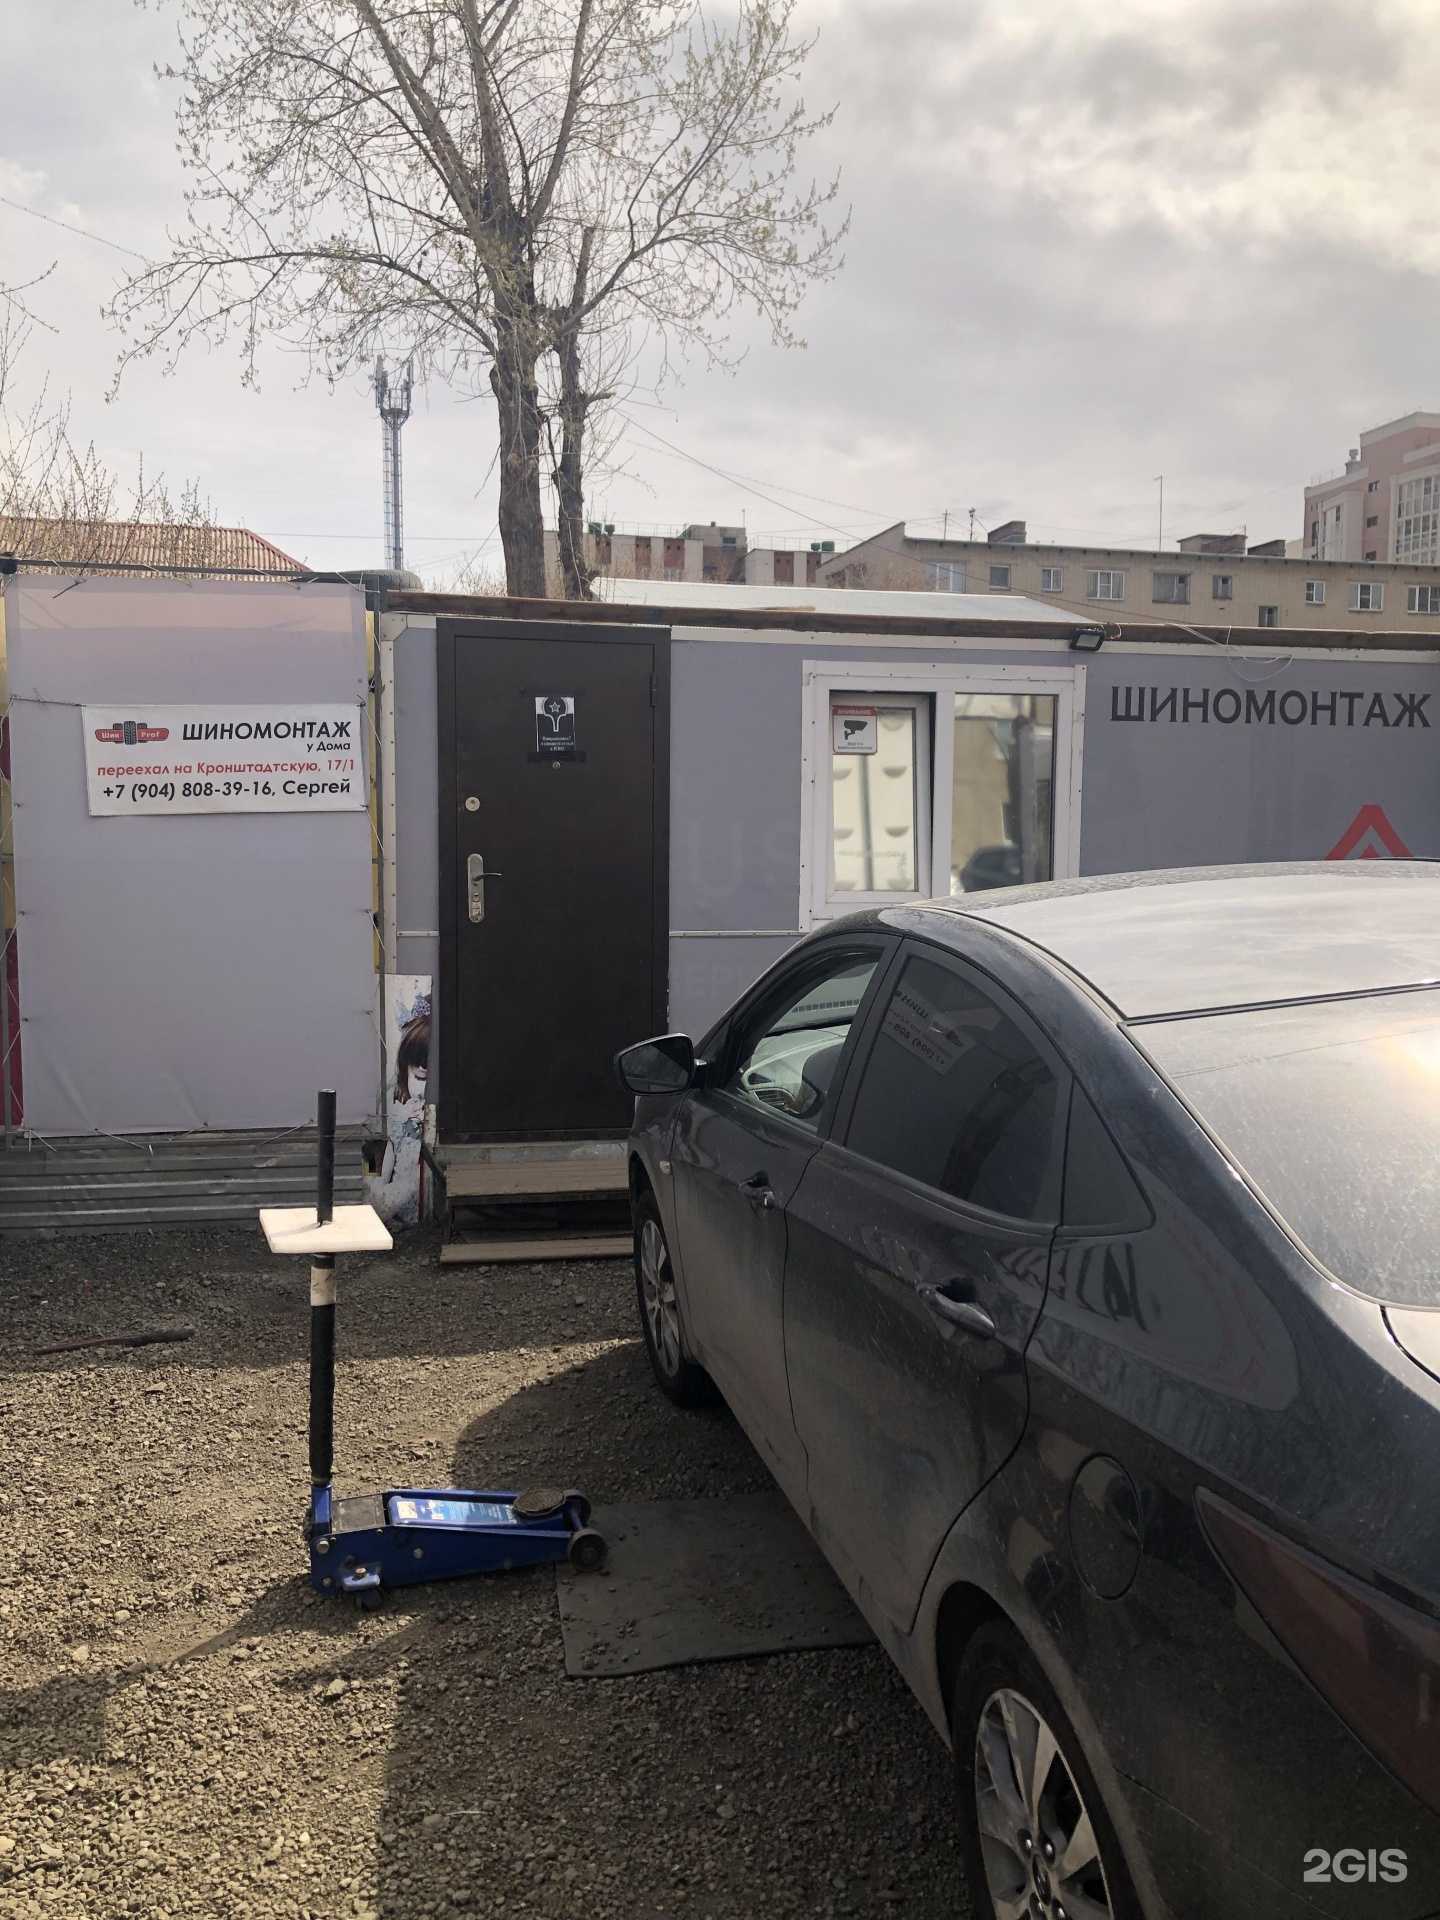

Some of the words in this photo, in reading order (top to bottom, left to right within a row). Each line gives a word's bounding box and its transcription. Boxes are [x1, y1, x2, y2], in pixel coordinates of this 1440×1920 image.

[1110, 686, 1432, 728] ШИНОМОНТАЖ
[183, 721, 351, 740] ШИНОМОНТАЖ
[306, 743, 313, 752] у
[316, 741, 351, 752] Дома
[97, 765, 170, 778] переехал
[174, 764, 192, 774] на
[197, 762, 321, 776] Кронштадтскую,
[328, 759, 355, 773] 17/1
[103, 784, 125, 799] +7
[131, 782, 175, 802] (904)
[182, 780, 276, 798] 808-39-16,
[282, 778, 351, 797] Сергей
